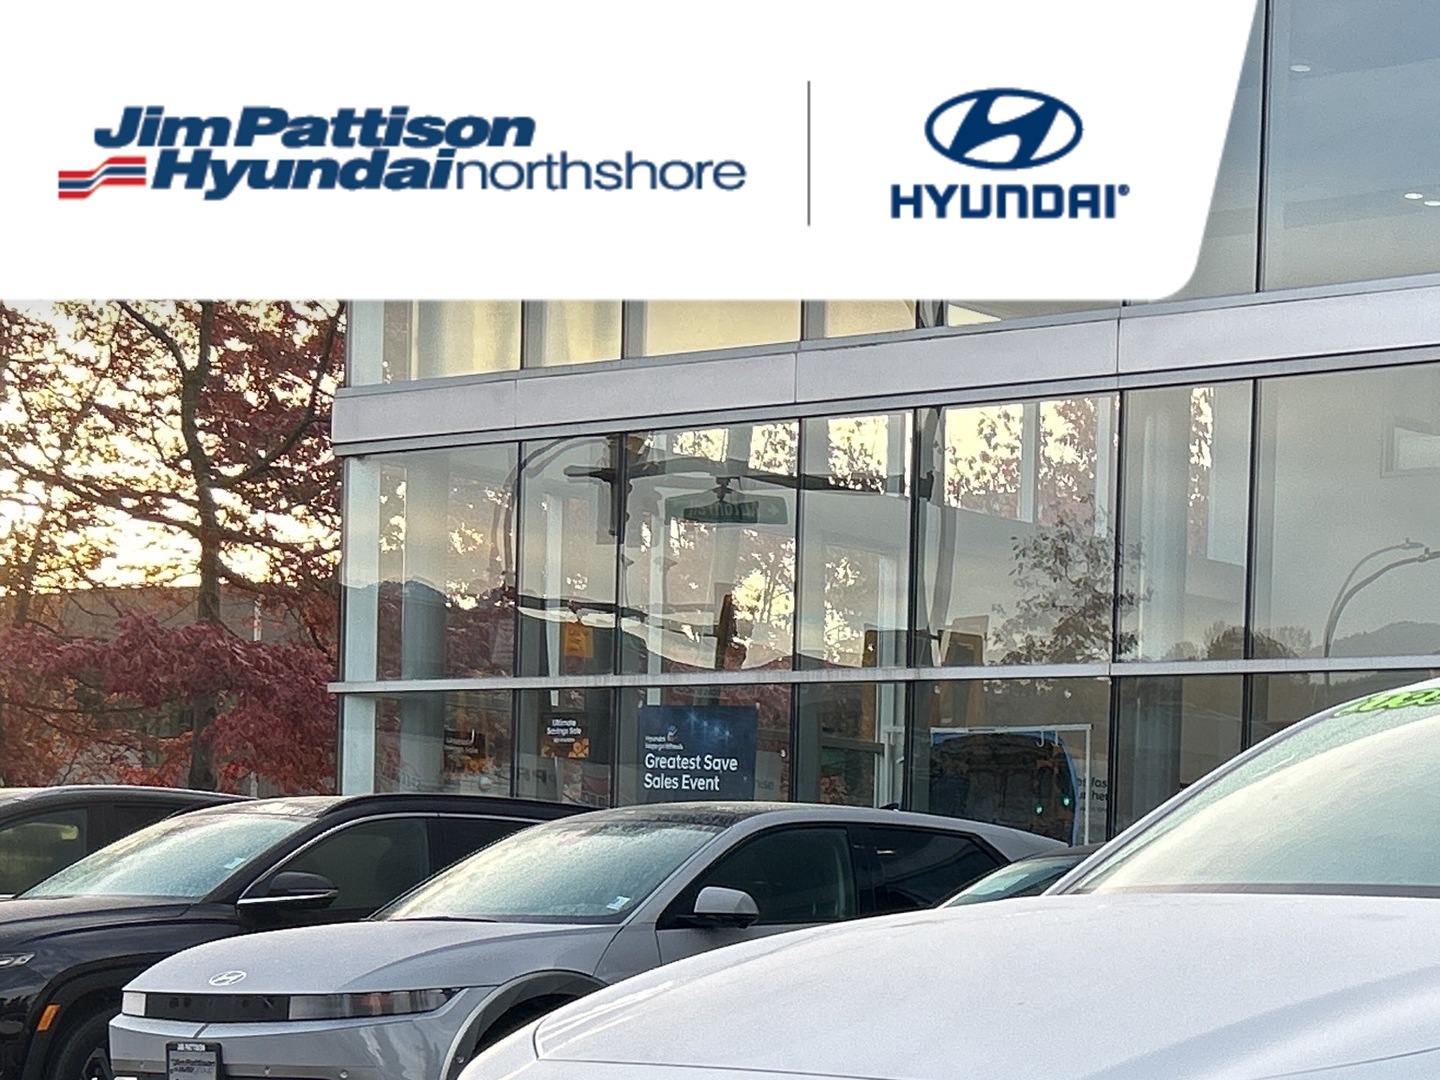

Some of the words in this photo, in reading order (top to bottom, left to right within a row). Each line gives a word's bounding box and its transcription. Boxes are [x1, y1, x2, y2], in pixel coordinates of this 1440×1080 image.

[644, 753, 701, 770] Greatest
[703, 755, 739, 773] Save
[643, 773, 679, 790] Sales
[681, 774, 720, 792] Event
